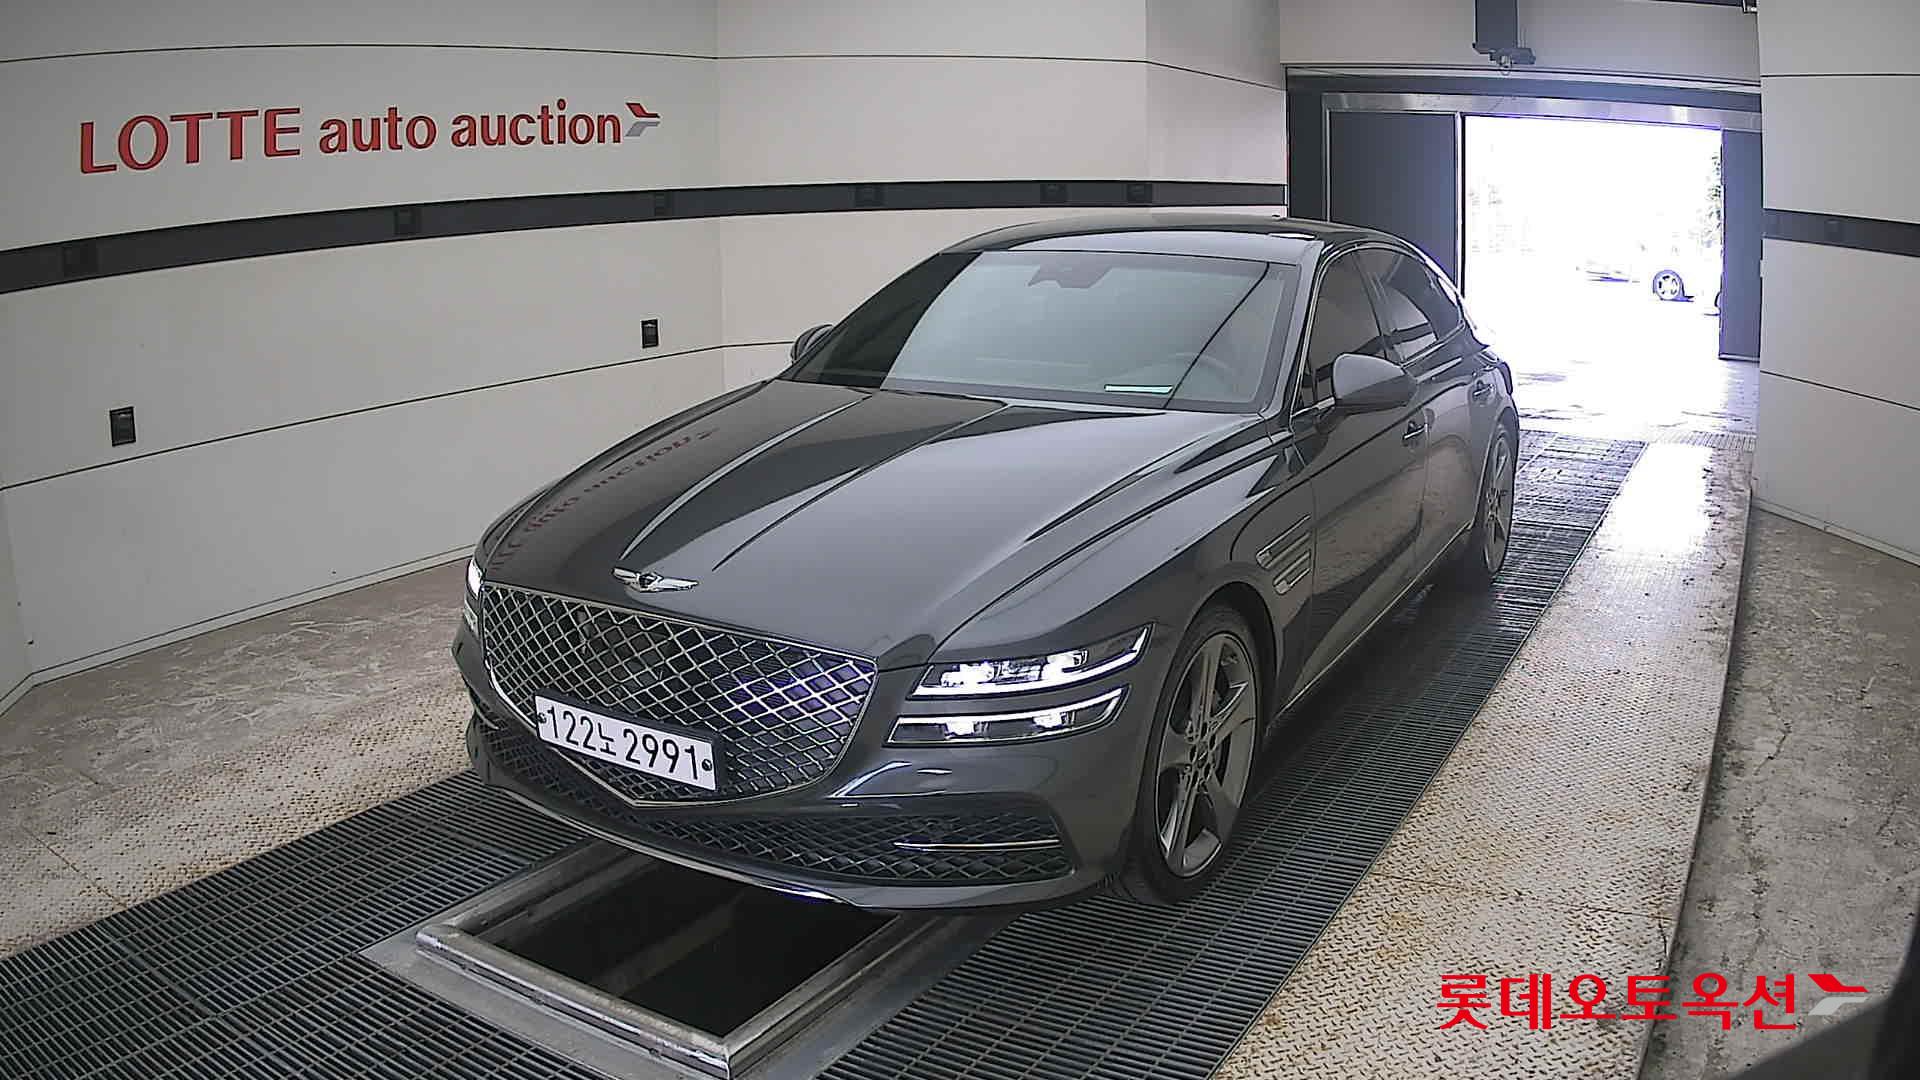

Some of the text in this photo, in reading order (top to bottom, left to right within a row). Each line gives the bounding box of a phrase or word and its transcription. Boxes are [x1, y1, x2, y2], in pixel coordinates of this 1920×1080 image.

[80, 98, 622, 174] LOTTE auto auction
[547, 706, 698, 780] 122노 2991
